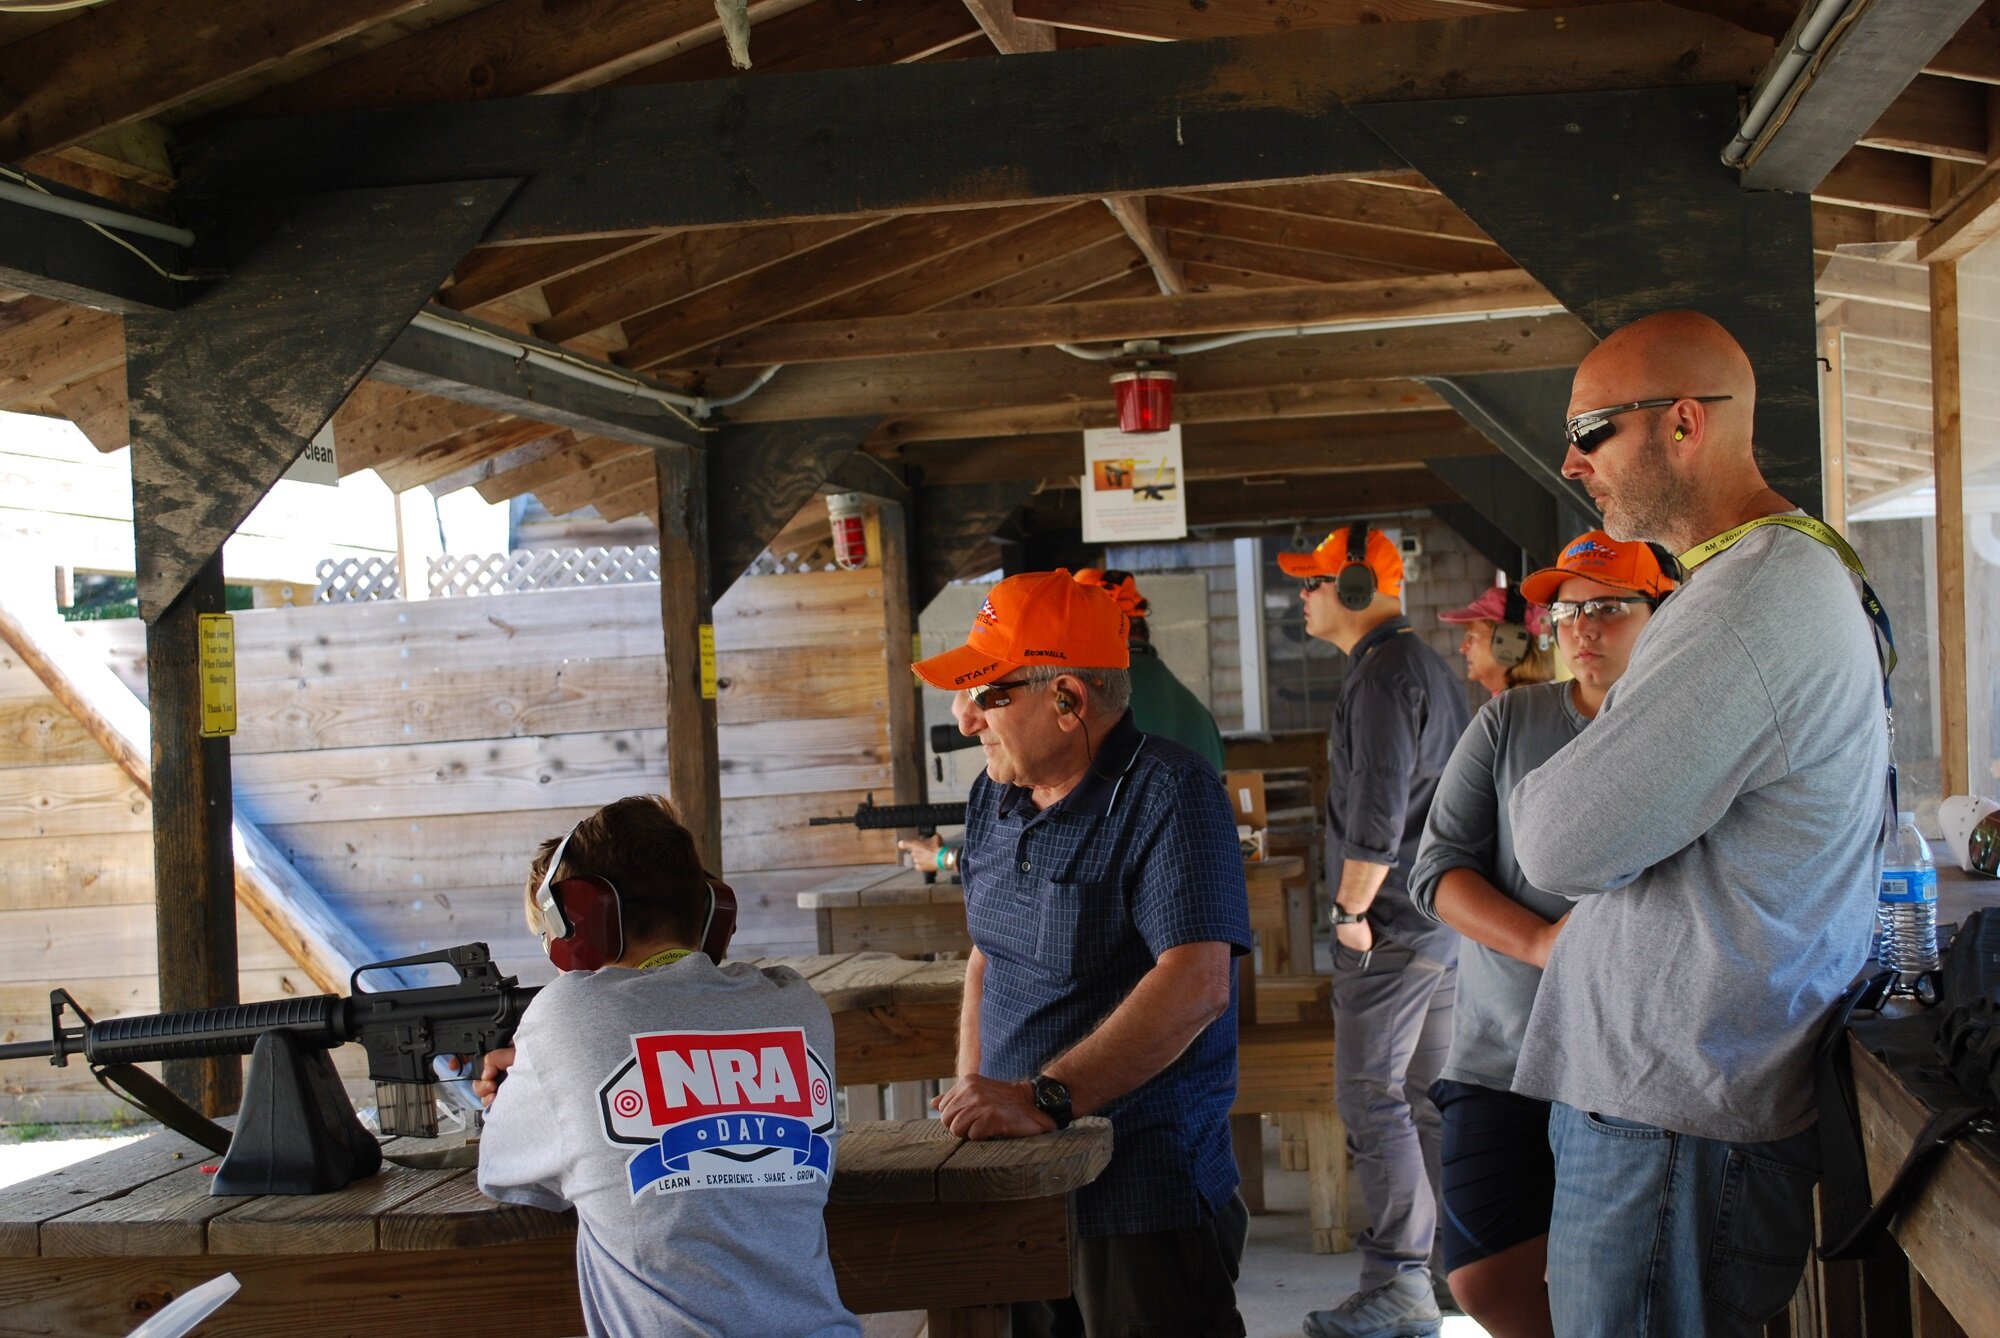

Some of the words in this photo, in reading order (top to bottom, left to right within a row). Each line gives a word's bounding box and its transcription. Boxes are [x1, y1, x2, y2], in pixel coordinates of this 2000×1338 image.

[304, 442, 334, 464] clean
[954, 663, 1000, 685] STAFF
[656, 1046, 801, 1109] NRA
[717, 1118, 766, 1141] DAY
[658, 1176, 691, 1191] LEARN
[706, 1173, 755, 1185] EXPERIENCE
[764, 1172, 786, 1183] SHARE
[797, 1169, 815, 1181] GROW
